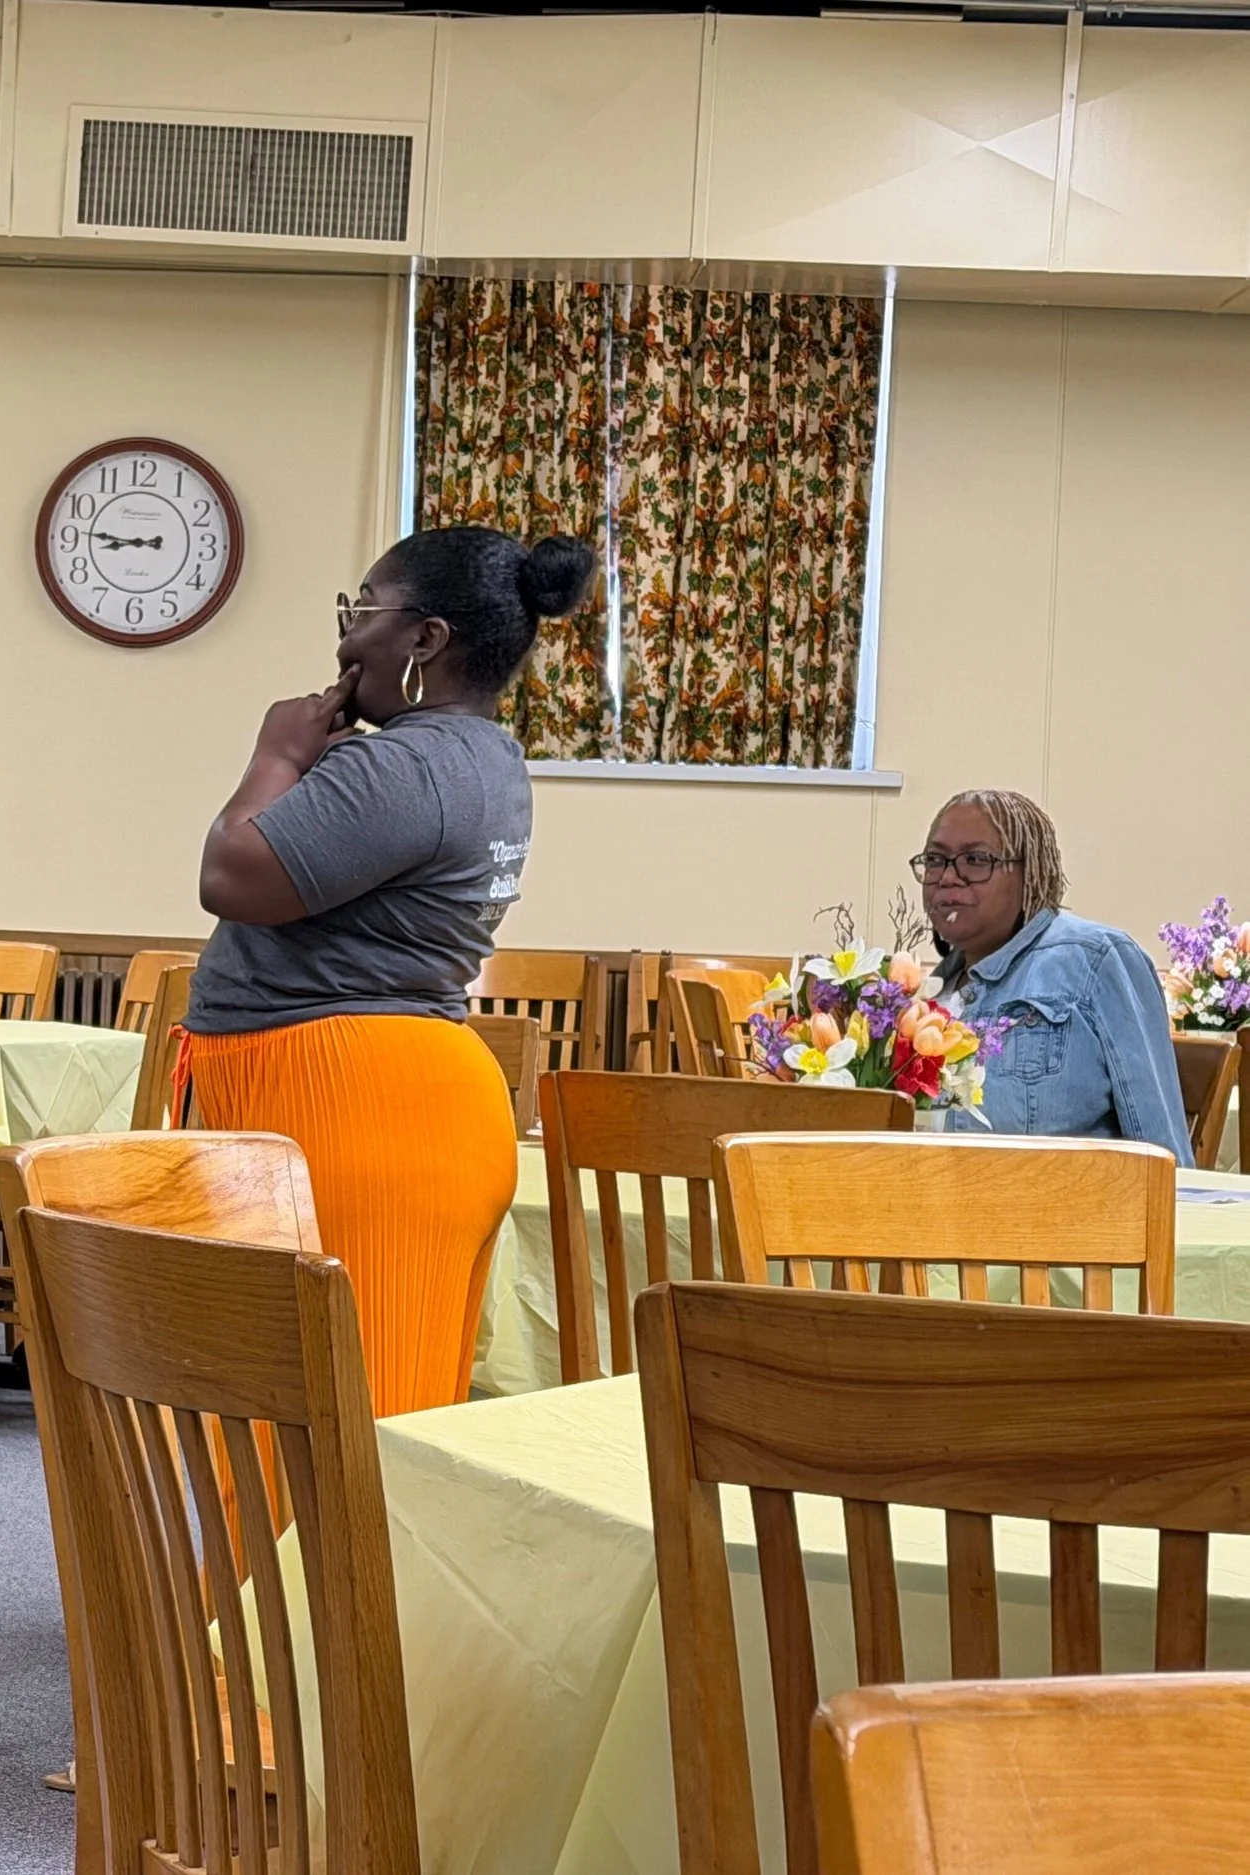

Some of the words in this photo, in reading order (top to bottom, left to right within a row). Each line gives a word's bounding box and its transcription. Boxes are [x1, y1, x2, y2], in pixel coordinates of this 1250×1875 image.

[97, 466, 120, 494] 11
[128, 460, 158, 488] 12
[172, 471, 184, 498] 1
[67, 493, 96, 520] 10
[192, 500, 211, 527] 2
[60, 525, 79, 553] 9
[198, 533, 217, 561] 3
[69, 557, 88, 584] 8
[185, 563, 206, 591] 4
[92, 586, 109, 613] 7
[125, 597, 143, 624] 6
[160, 590, 178, 618] 5
